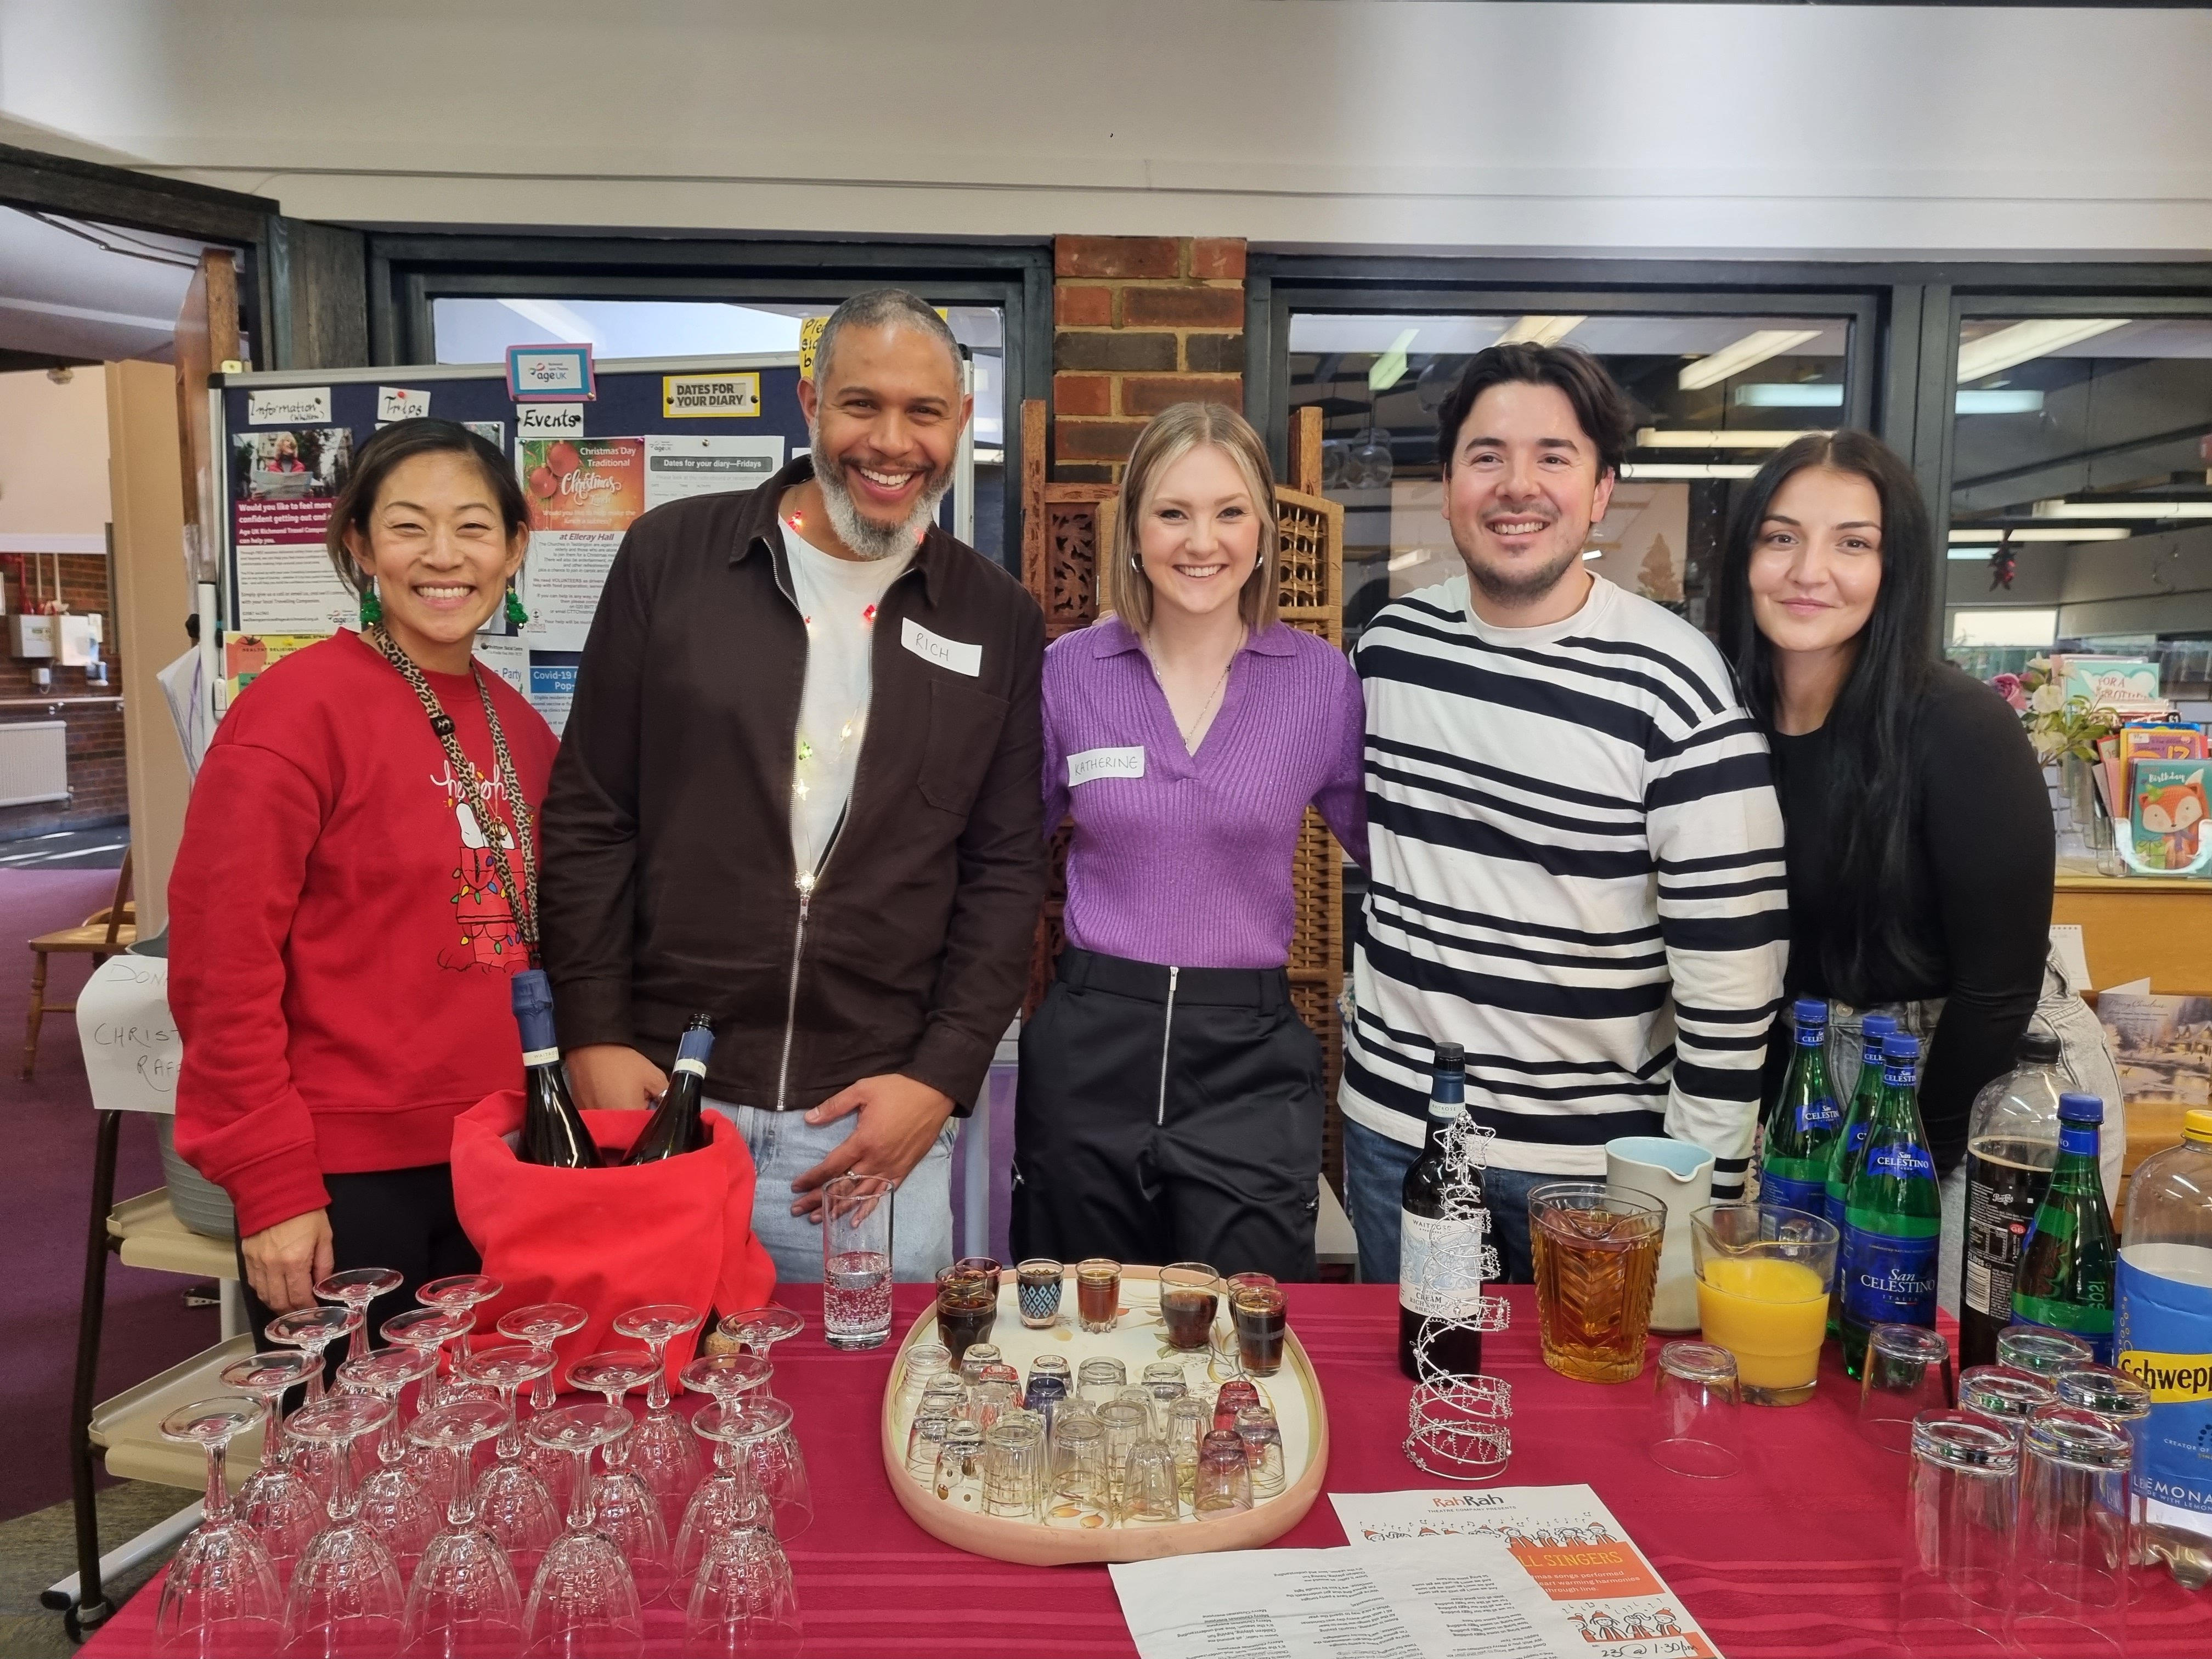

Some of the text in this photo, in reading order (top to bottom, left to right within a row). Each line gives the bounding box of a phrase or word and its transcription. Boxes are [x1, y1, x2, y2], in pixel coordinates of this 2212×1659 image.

[677, 384, 734, 396] DATES FOR
[384, 396, 422, 418] Trips
[677, 394, 743, 407] YOUR DIARY
[251, 399, 316, 419] Information
[523, 409, 577, 427] Events
[580, 447, 636, 456] Christmas Day
[561, 469, 622, 505] Christmas
[274, 514, 299, 524] getting
[313, 512, 326, 521] and
[568, 533, 597, 542] Elleray
[916, 633, 949, 661] RICH
[503, 668, 521, 682] Party
[533, 671, 571, 679] Covid-19
[2098, 677, 2124, 687] FOR A
[1075, 756, 1138, 776] KATHERINE
[2149, 772, 2185, 782] Birthday
[105, 964, 167, 985] DON
[137, 1054, 180, 1092] RAF
[1877, 1157, 1928, 1168] CELESTINO
[1888, 1268, 1915, 1281] San
[1861, 1274, 1935, 1293] CELESTINO
[1410, 1297, 1424, 1307] RICH
[2121, 1359, 2212, 1394] Schwep
[2164, 1438, 2197, 1451] CREATOR
[1432, 1494, 1504, 1507] RahRah
[2160, 1495, 2180, 1504] WITH
[1544, 1551, 1623, 1566] SINGERS
[1581, 1570, 1624, 1579] performed
